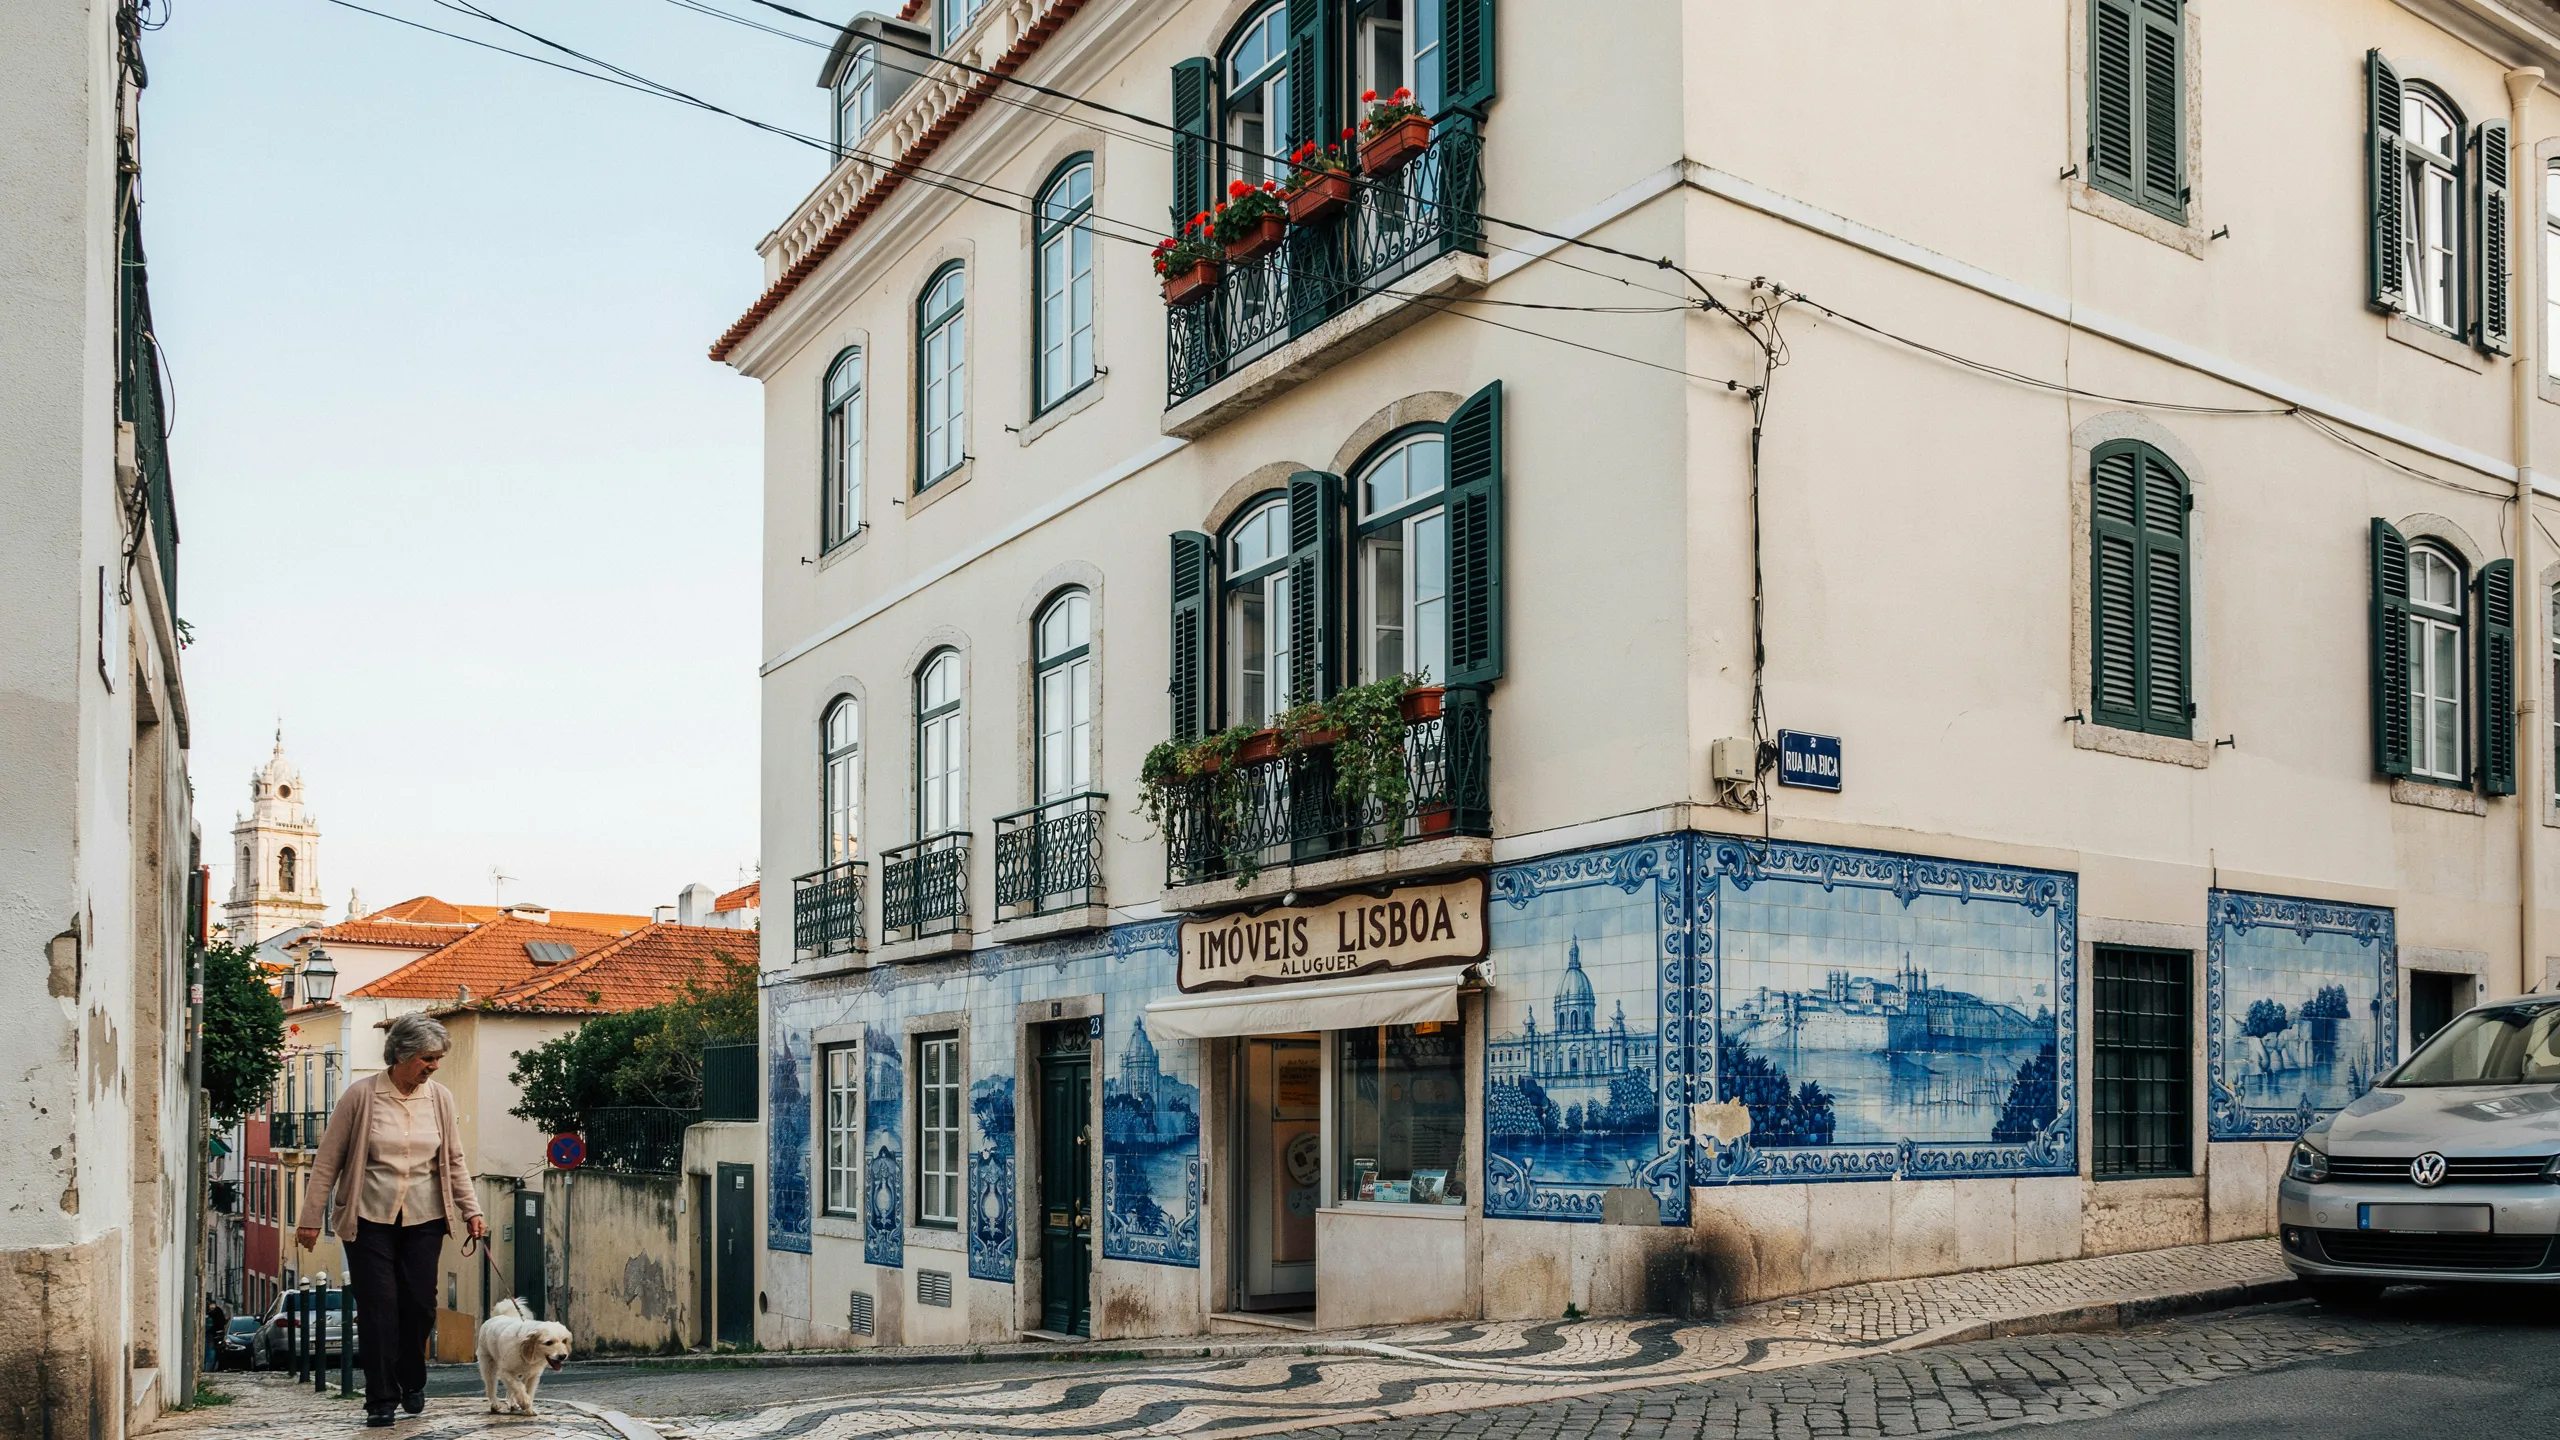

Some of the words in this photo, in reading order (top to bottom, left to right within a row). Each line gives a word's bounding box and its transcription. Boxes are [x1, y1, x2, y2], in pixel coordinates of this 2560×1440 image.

[1786, 751, 1803, 772] RUA
[1805, 753, 1817, 774] DA
[1818, 754, 1839, 777] BICA
[1199, 917, 1308, 970] IMÓVEIS
[1337, 897, 1456, 953] LISBOA
[1280, 954, 1358, 975] ALUGUER
[1090, 1017, 1100, 1035] 23
